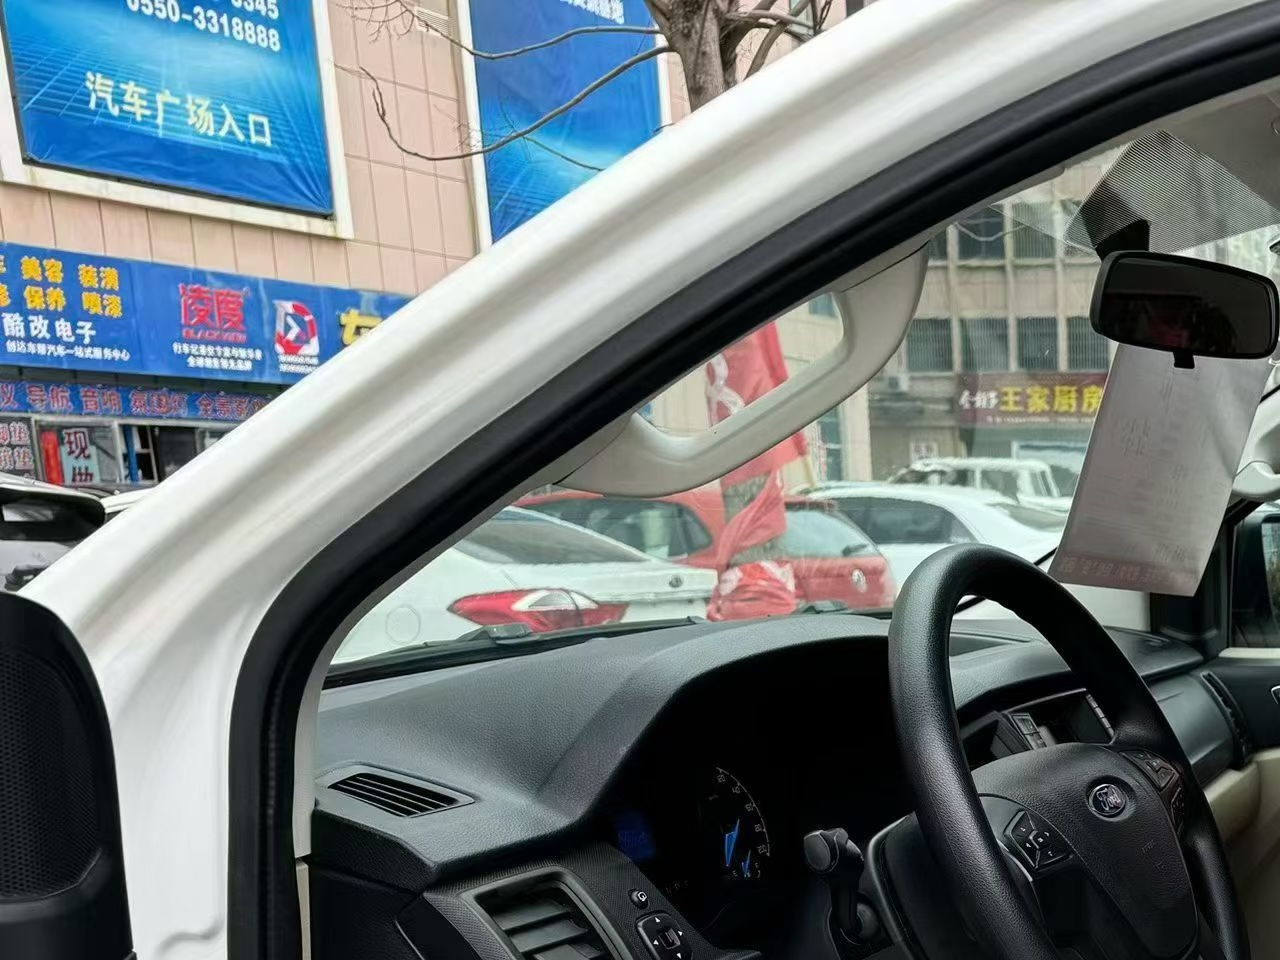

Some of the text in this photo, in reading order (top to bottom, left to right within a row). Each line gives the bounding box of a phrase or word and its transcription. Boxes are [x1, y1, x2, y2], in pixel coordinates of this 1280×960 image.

[84, 70, 273, 148] 汽车广场入口
[23, 284, 66, 312] 保养
[178, 283, 246, 332] 凌度
[1, 312, 97, 345] 酷改电子
